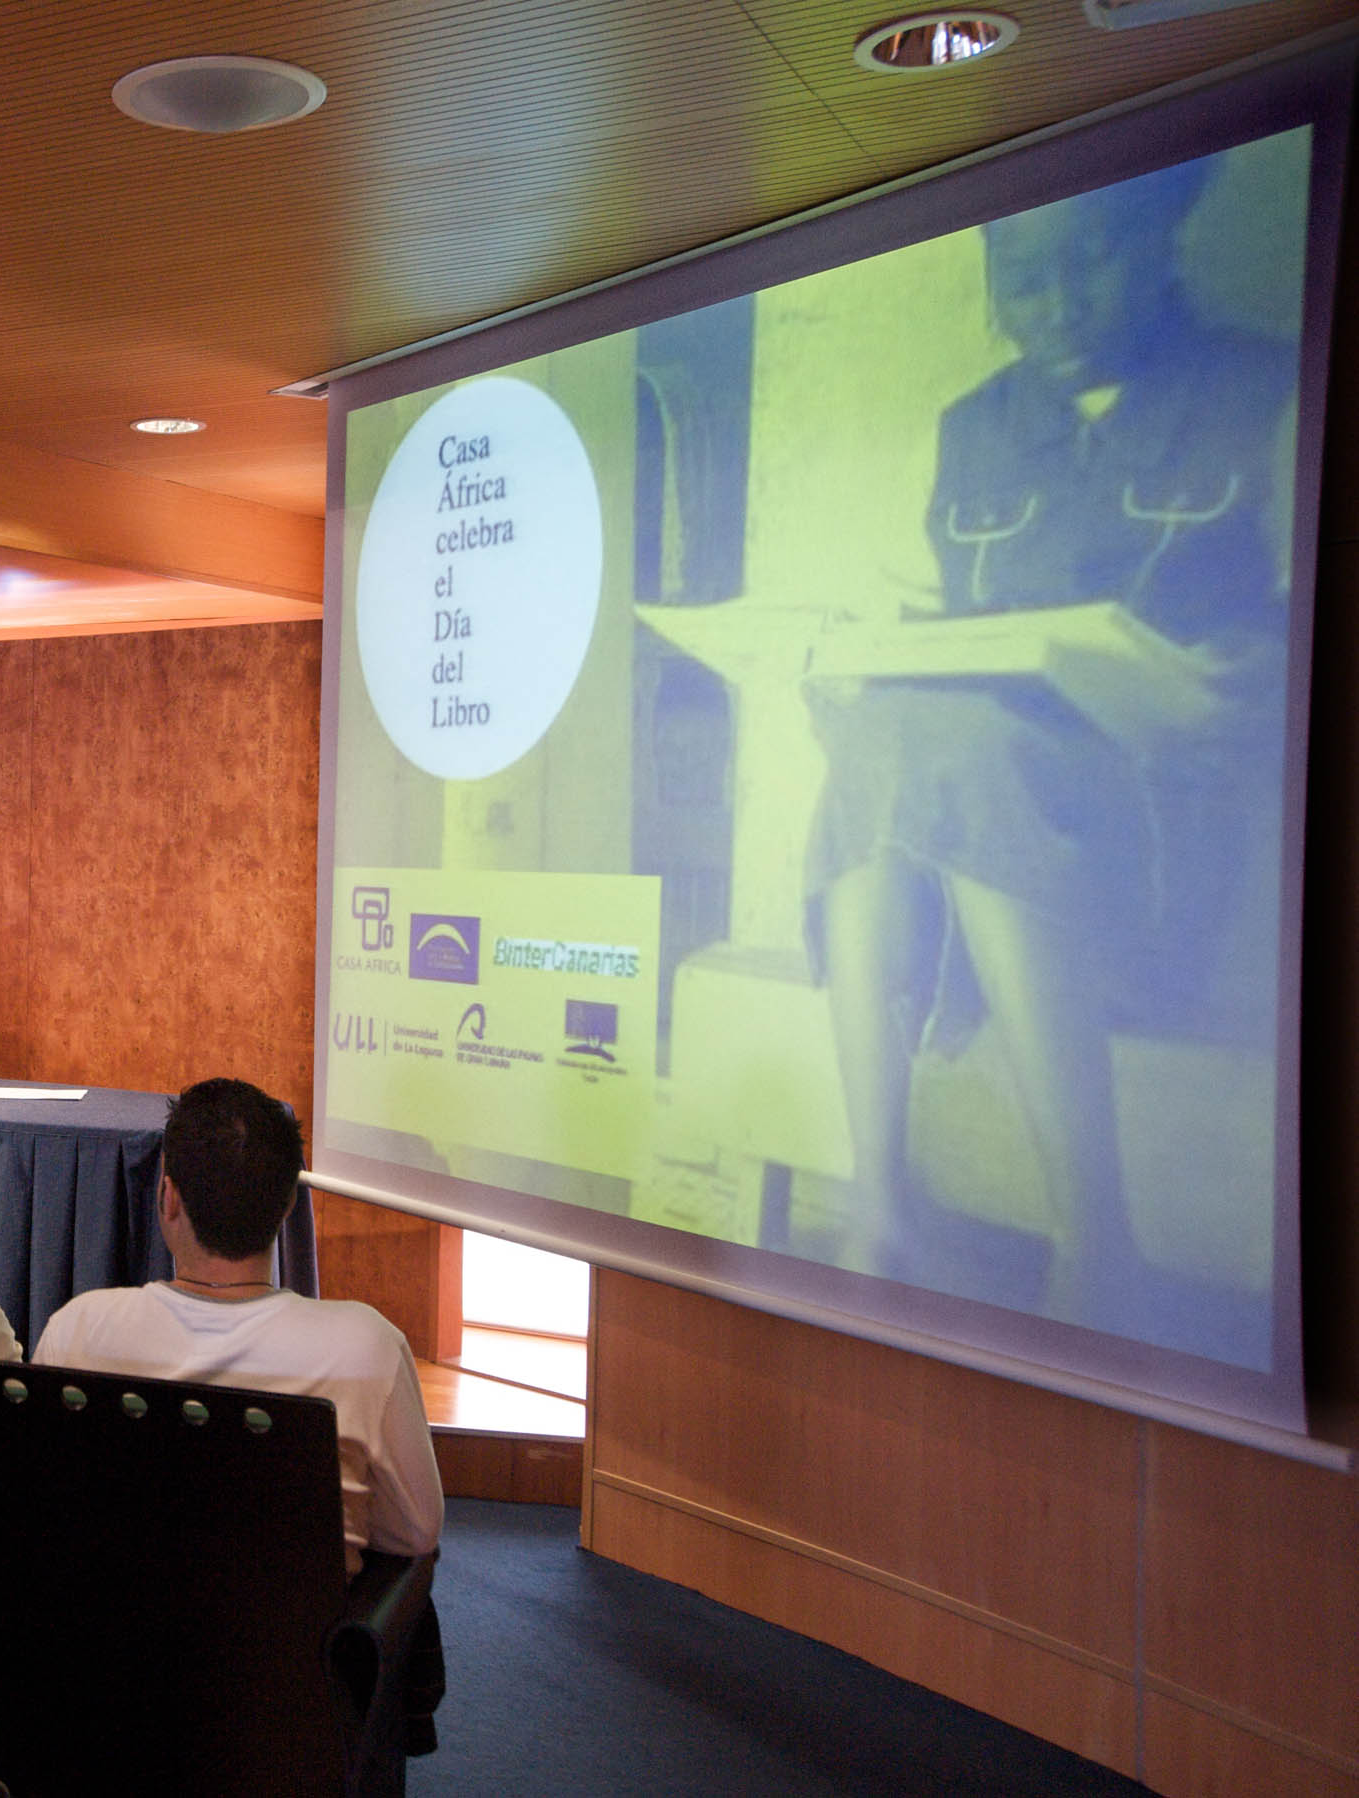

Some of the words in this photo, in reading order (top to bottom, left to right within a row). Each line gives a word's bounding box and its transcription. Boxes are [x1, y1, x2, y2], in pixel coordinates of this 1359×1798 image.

[438, 433, 490, 468] Casa
[437, 470, 506, 513] África
[435, 517, 515, 554] celebra
[434, 565, 453, 598] el
[433, 608, 472, 642] Día
[432, 651, 464, 685] del
[431, 697, 490, 729] Libro
[337, 955, 362, 971] CASA
[364, 957, 402, 976] AFRICA
[493, 936, 640, 979] BinterCanarias
